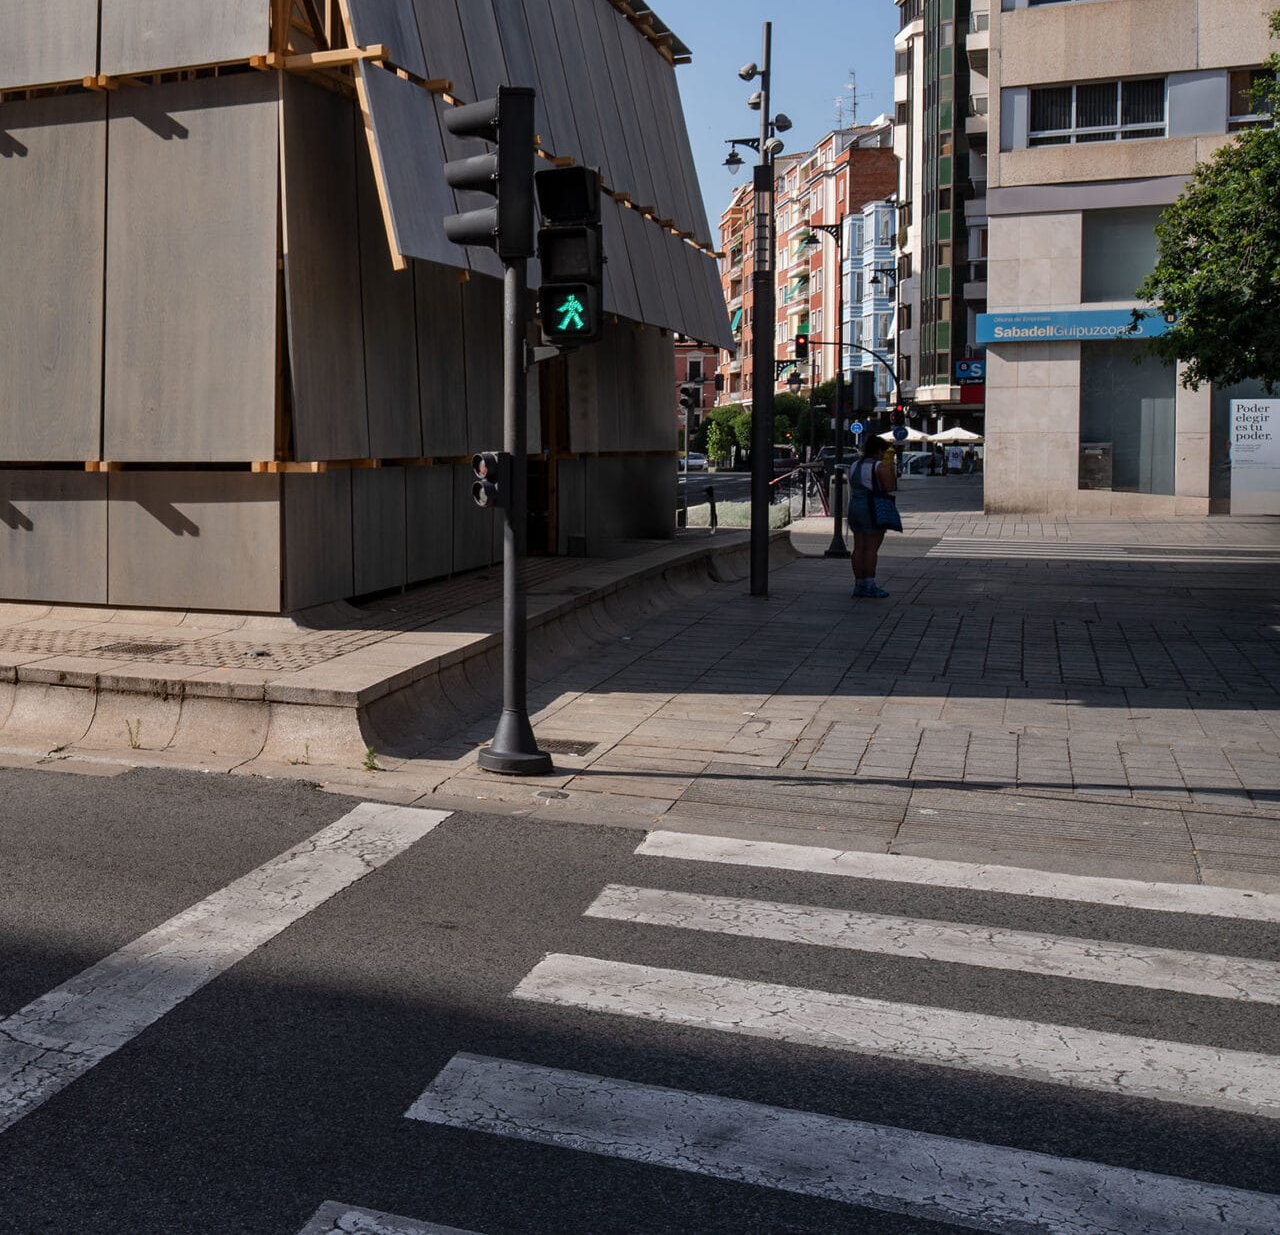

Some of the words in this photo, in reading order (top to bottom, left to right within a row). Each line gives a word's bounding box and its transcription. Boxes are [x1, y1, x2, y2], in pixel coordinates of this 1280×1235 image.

[1236, 403, 1270, 413] Poder
[1235, 413, 1270, 424] elegir
[1235, 424, 1248, 432] es
[1250, 423, 1263, 432] tu
[1235, 431, 1273, 442] poder.
